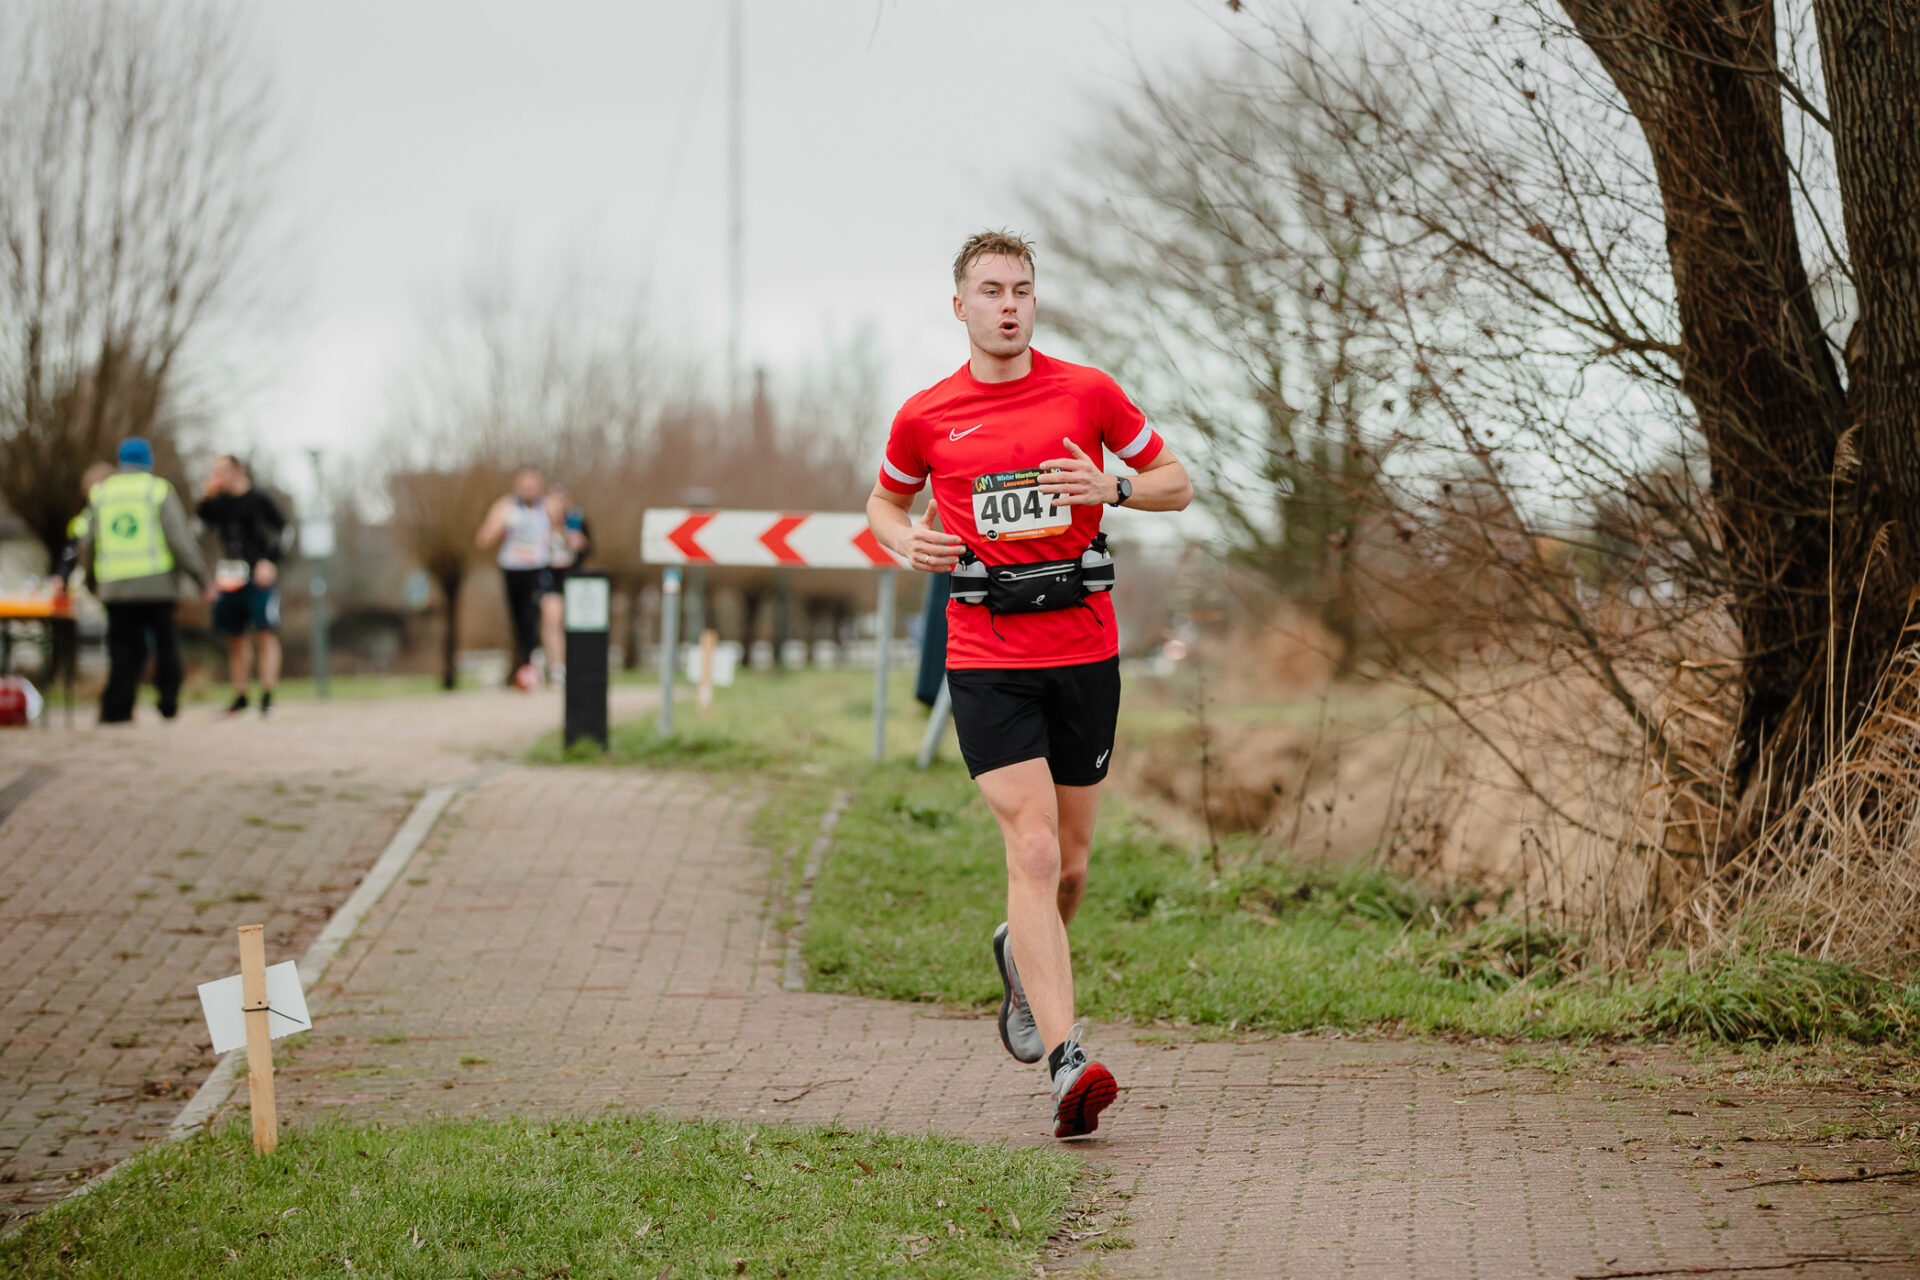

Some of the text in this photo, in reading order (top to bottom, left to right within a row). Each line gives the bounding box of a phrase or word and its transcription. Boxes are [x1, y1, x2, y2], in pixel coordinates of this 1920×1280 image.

[1015, 471, 1040, 479] Marathon
[1003, 478, 1035, 487] Leeuwarden
[981, 490, 1061, 525] 4047
